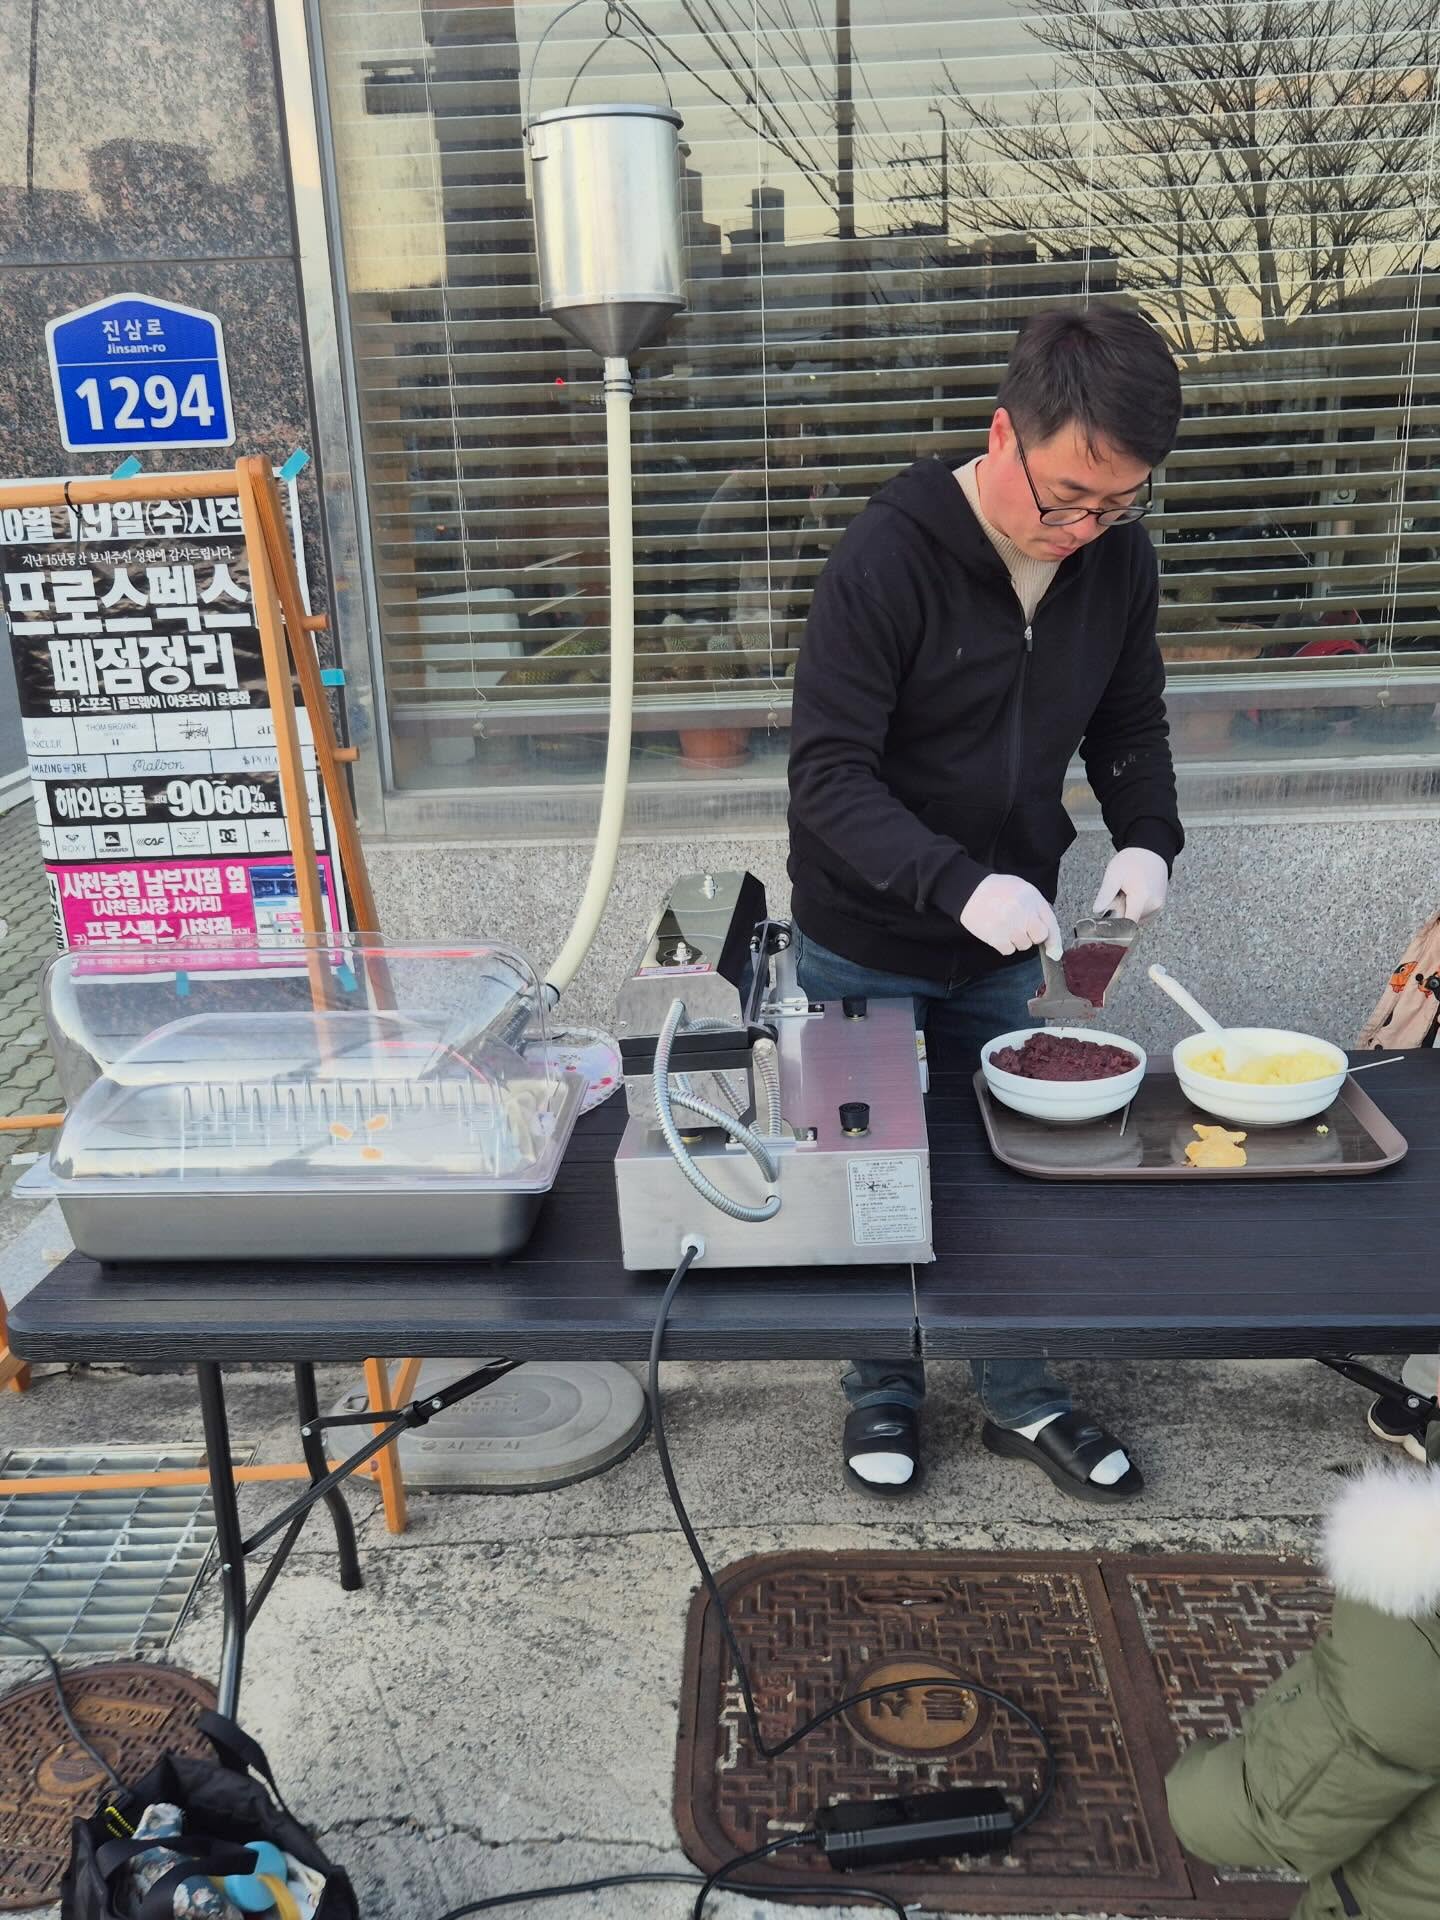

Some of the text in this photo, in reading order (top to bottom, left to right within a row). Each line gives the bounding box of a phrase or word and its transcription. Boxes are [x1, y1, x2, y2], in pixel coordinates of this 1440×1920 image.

[102, 318, 164, 342] 진삼로
[106, 342, 166, 354] Jinsam-ro
[75, 373, 215, 431] 1294
[21, 553, 43, 568] 지난
[90, 549, 132, 564] 보내주신
[135, 548, 166, 563] 성원에
[168, 545, 235, 562] 감사드립니다.
[4, 564, 251, 635] 프로스펙스
[48, 632, 239, 695] 폐점정리
[49, 699, 72, 713] 명품
[79, 697, 112, 711] 스포츠
[117, 695, 161, 711] 골프웨어
[167, 693, 211, 708] 아웃도어
[132, 759, 185, 771] Malbon
[54, 785, 147, 819] 해외명품
[251, 801, 278, 814] SALE
[63, 866, 248, 899] 사천농협 남부지점 옆
[92, 895, 222, 917] (사천읍시장 사거리)
